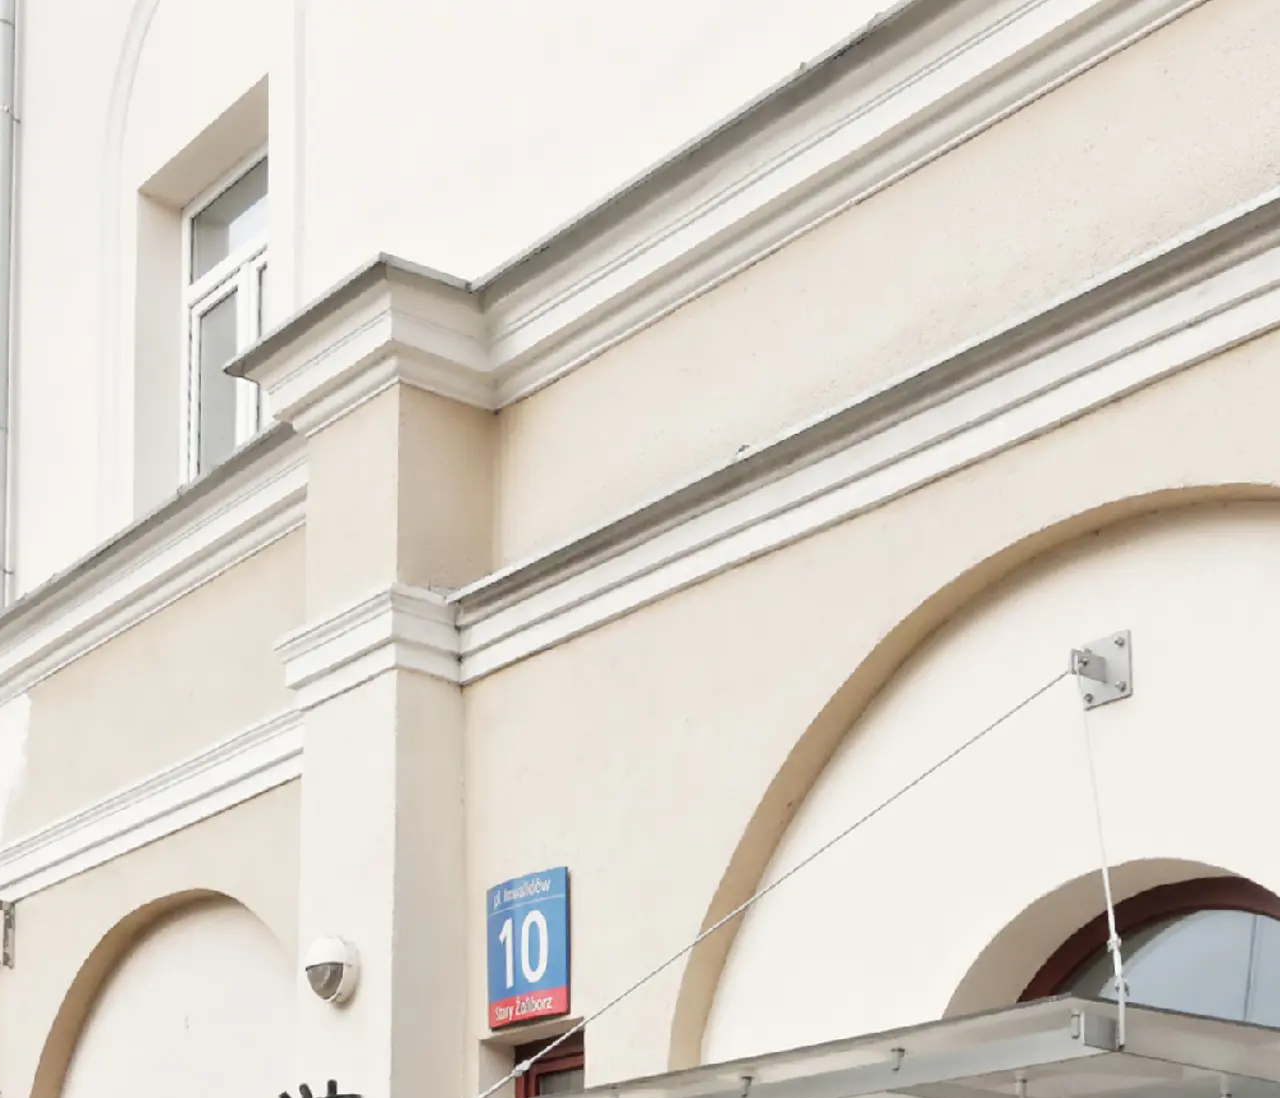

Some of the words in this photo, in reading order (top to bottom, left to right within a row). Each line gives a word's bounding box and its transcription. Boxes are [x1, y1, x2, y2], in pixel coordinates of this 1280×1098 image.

[503, 877, 552, 903] Inwalidów
[498, 909, 549, 990] 10
[495, 1004, 514, 1022] Stary
[515, 996, 554, 1015] Żoliborz
